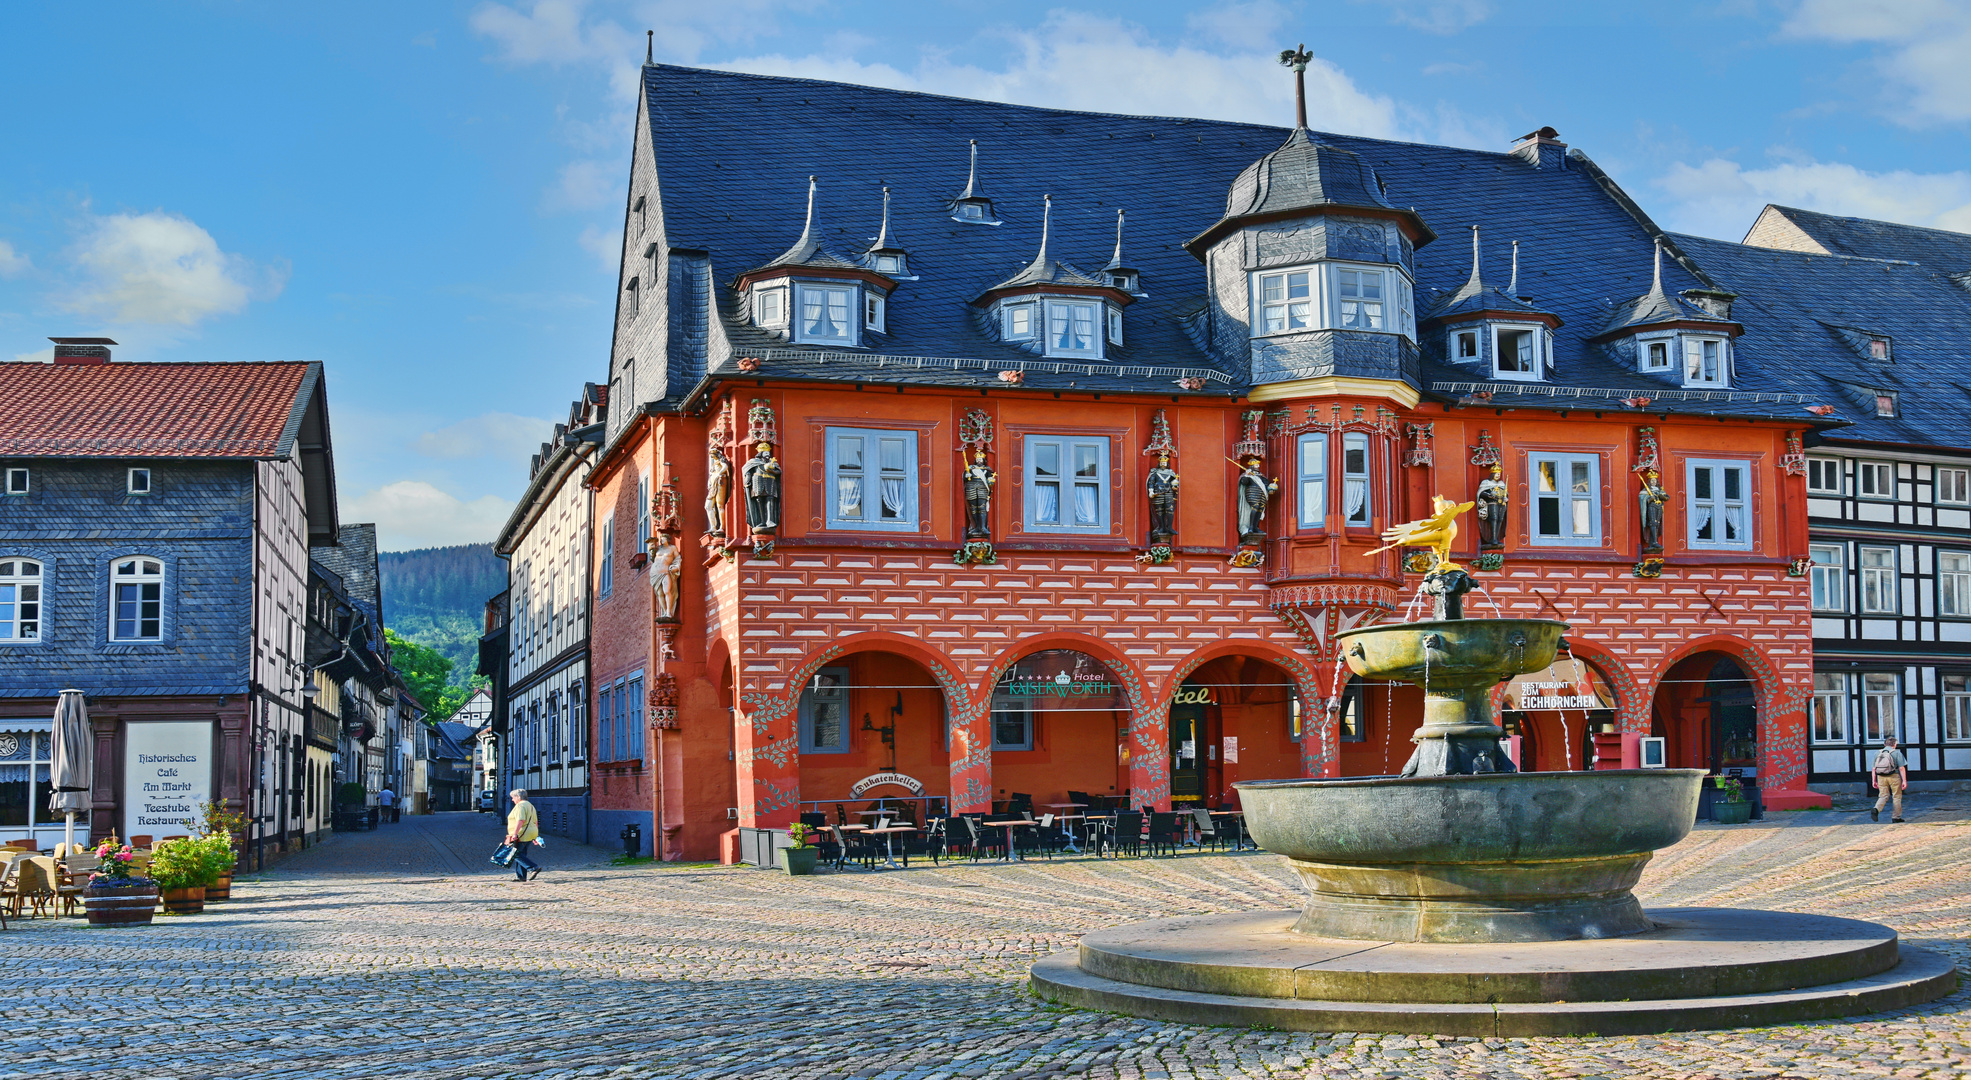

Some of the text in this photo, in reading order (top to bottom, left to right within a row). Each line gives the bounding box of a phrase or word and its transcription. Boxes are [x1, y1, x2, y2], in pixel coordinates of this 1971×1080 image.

[1074, 673, 1105, 681] Hotel
[1009, 682, 1111, 698] KAISERWORTH
[1173, 687, 1212, 704] tel
[138, 753, 197, 764] Historisches
[157, 768, 178, 777] Café
[143, 782, 192, 792] Am Markt
[855, 774, 919, 793] Dukatenkeller
[144, 803, 190, 813] Teestube
[137, 816, 196, 825] Restaurant
